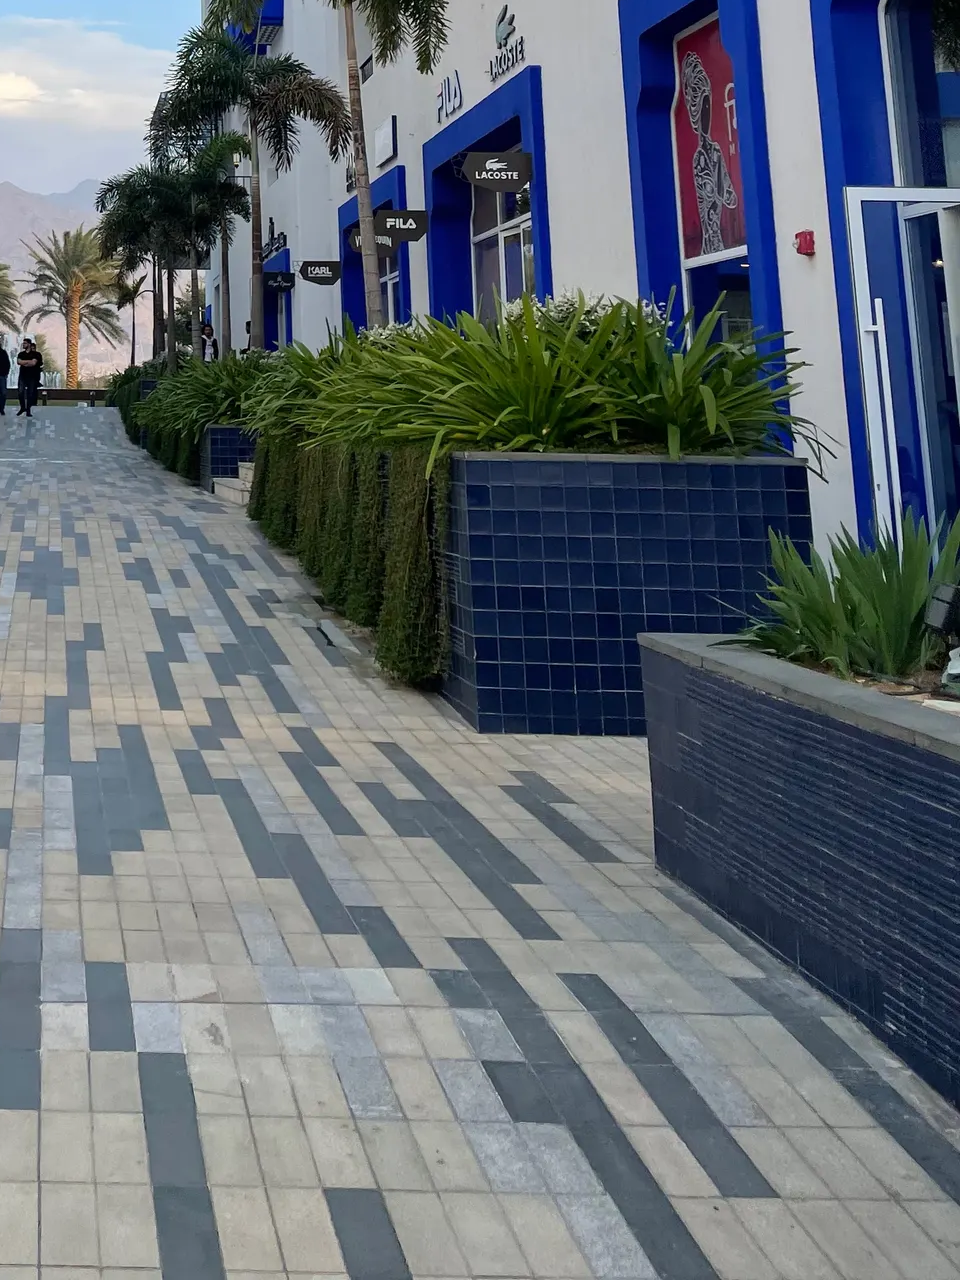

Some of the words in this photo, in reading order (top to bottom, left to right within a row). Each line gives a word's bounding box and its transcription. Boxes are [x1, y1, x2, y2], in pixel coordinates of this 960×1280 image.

[489, 36, 526, 82] LACOSTE
[437, 70, 464, 124] FILA
[475, 171, 519, 180] LACOSTE
[385, 218, 417, 229] FILA
[307, 266, 333, 275] KARL
